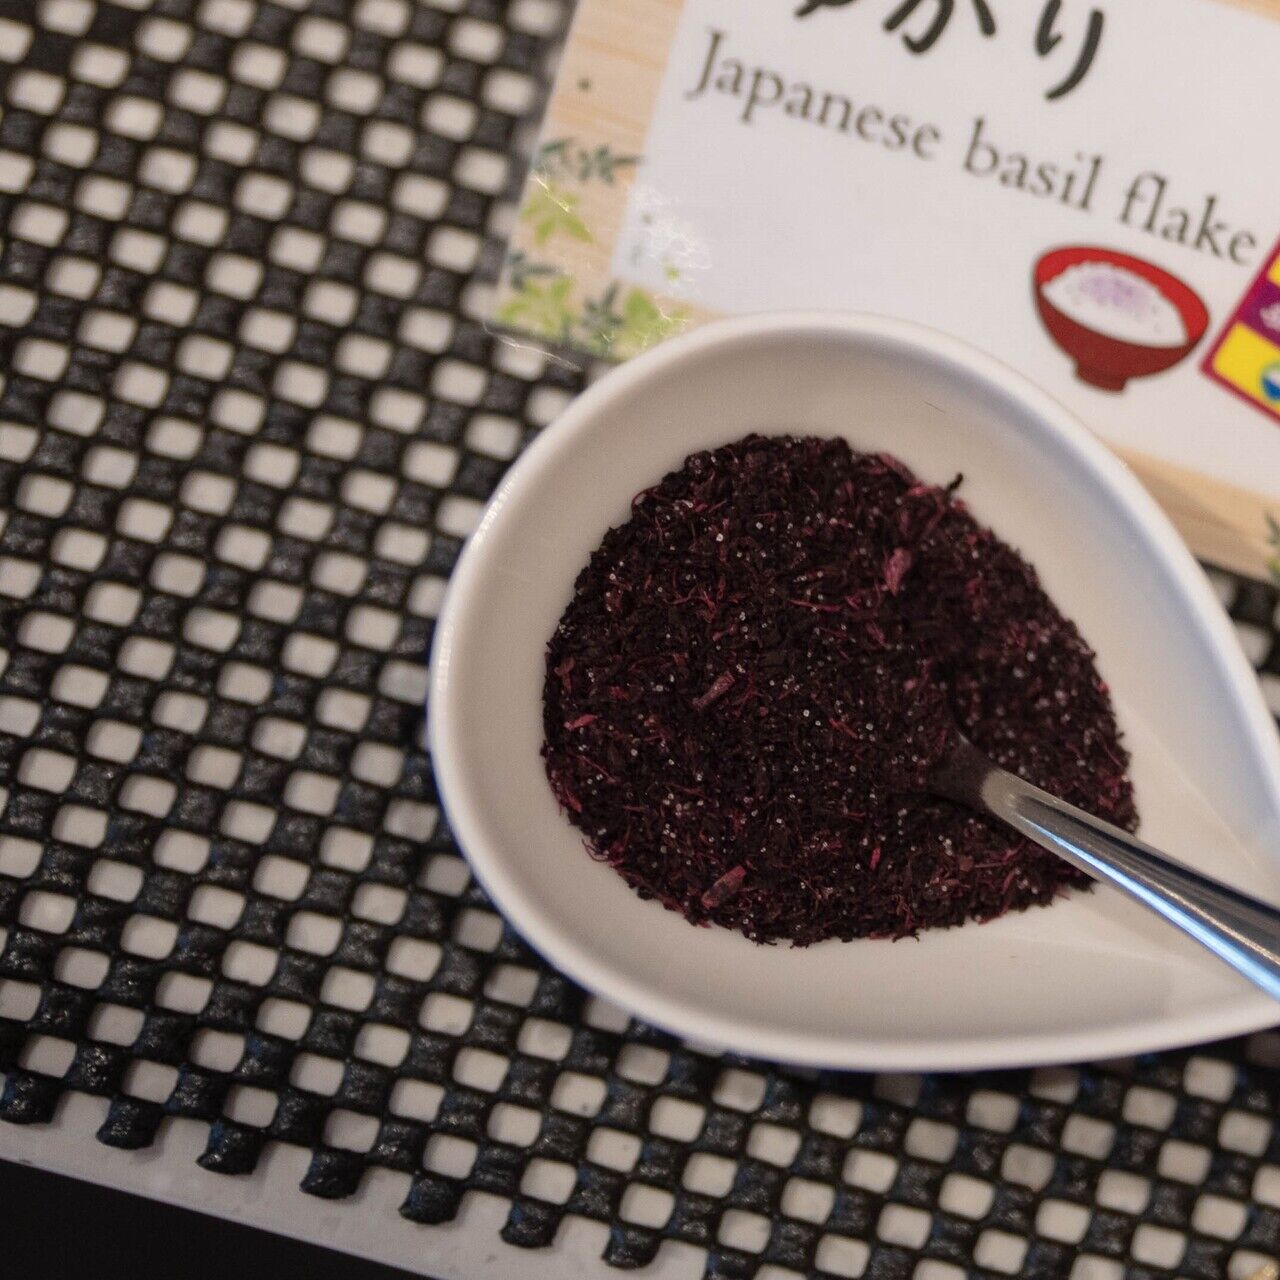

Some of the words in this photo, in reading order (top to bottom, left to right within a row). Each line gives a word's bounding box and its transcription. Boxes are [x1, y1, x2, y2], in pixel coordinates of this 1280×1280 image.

[685, 25, 942, 161] Japanese
[963, 116, 1104, 213] basil
[1117, 170, 1259, 267] flake
